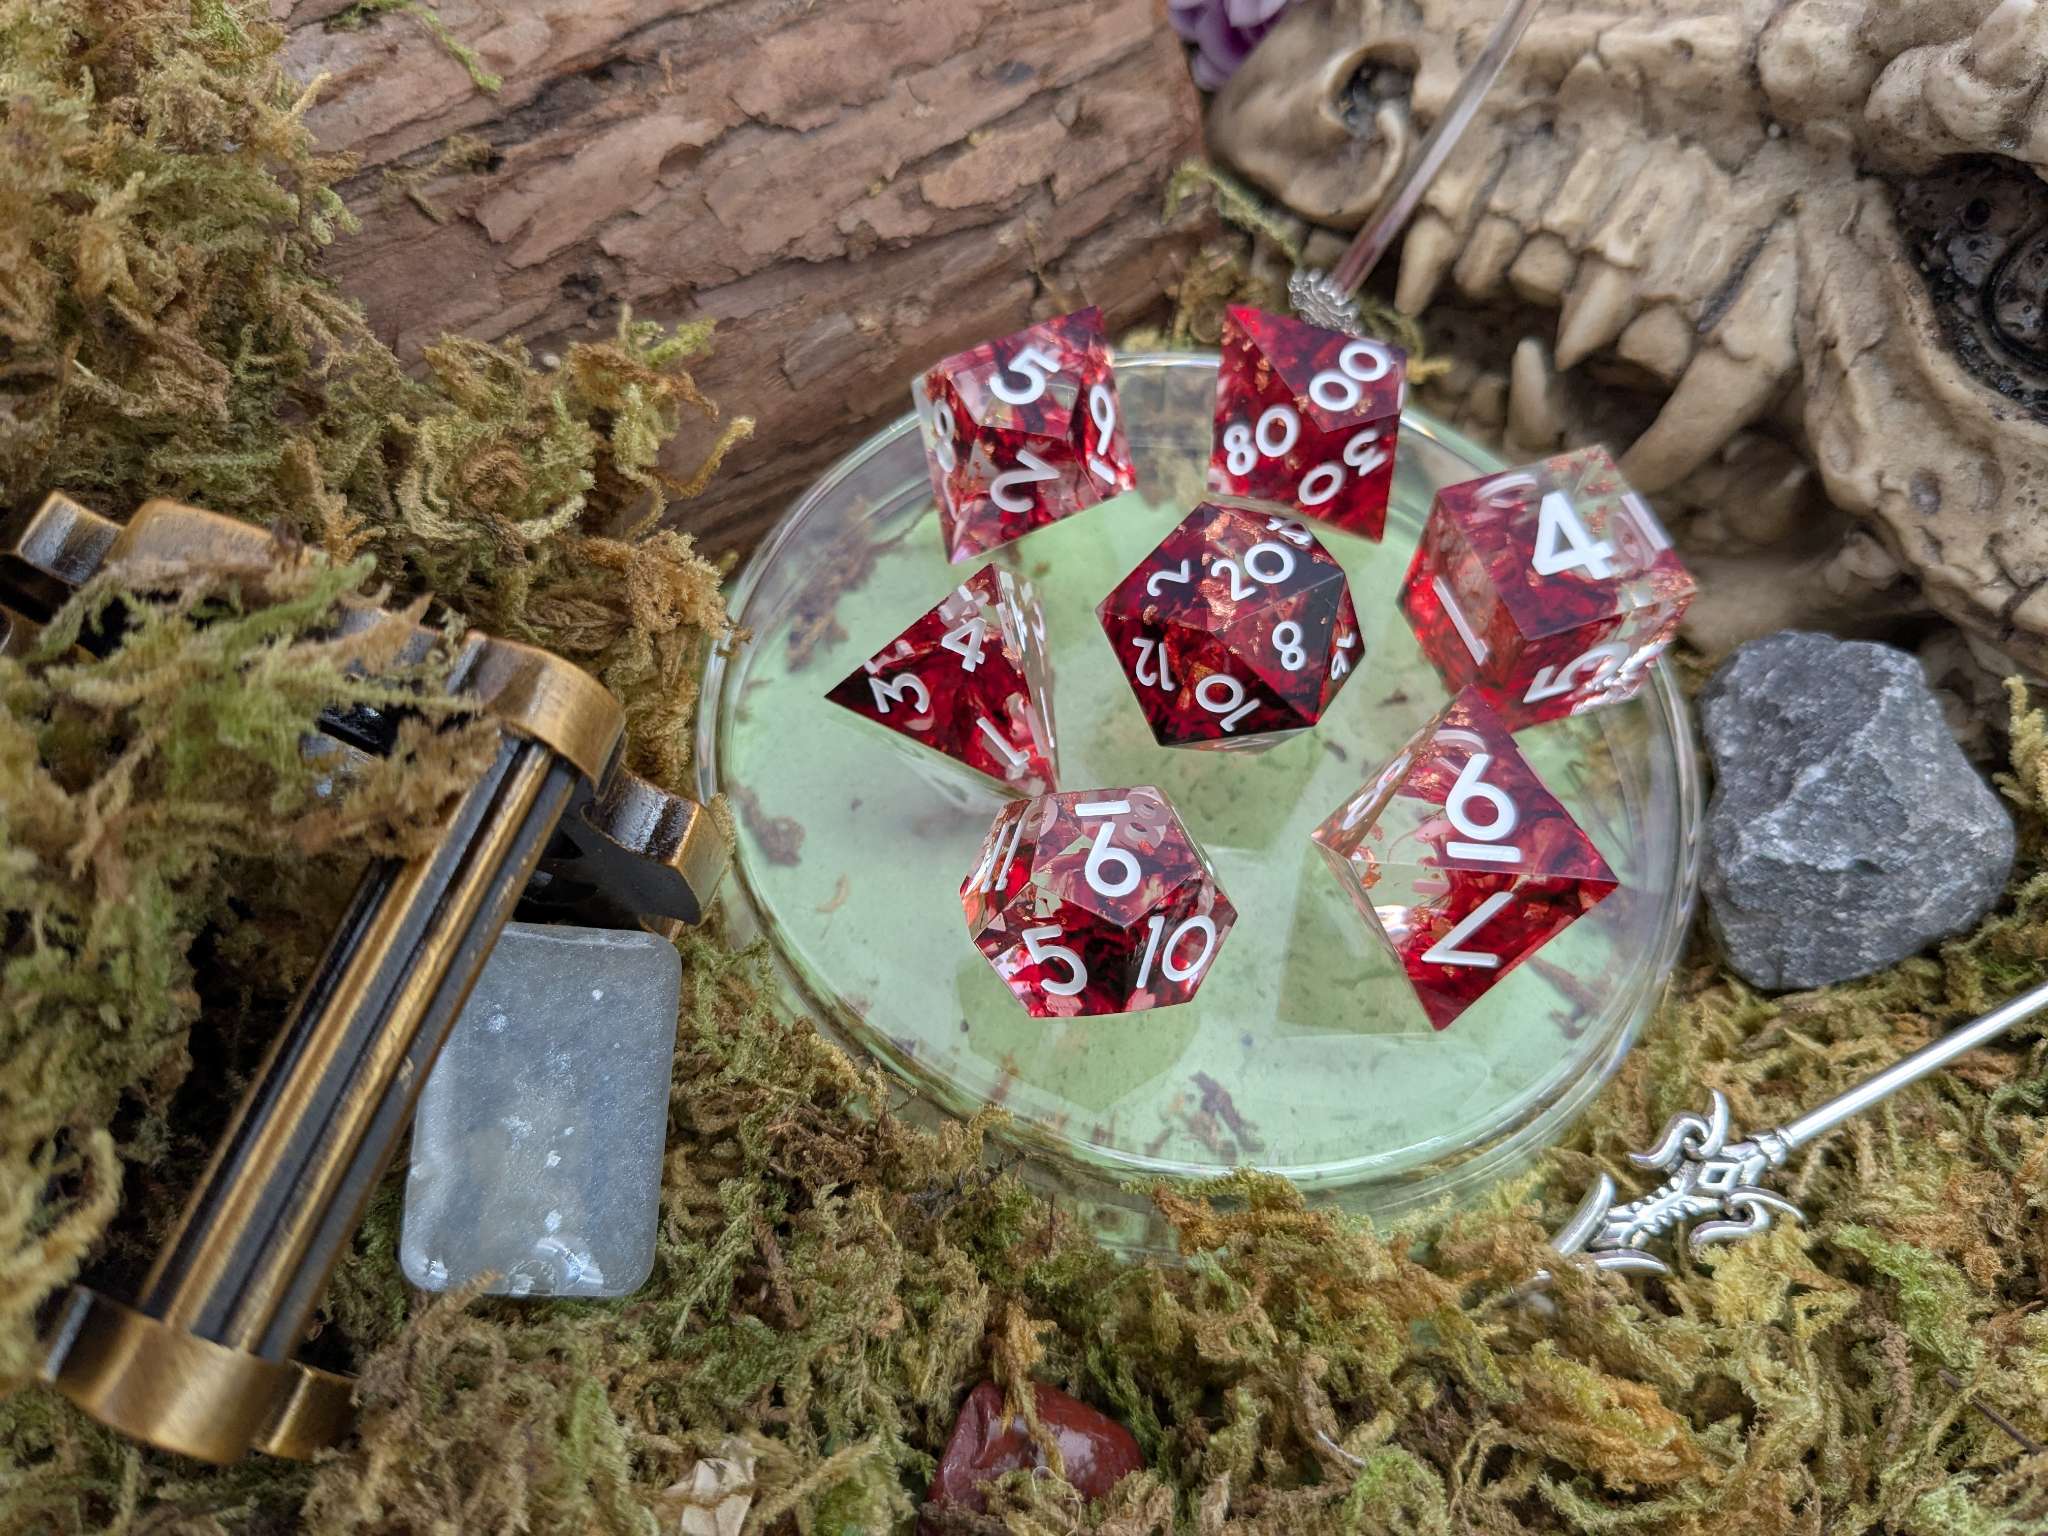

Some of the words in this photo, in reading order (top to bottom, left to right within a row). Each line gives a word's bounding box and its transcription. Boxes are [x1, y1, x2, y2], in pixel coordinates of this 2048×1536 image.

[989, 346, 1061, 405] 5
[1309, 340, 1392, 412] 00
[1223, 403, 1300, 477] 80
[1531, 490, 1616, 580] 4
[1146, 559, 1190, 597] 2
[1210, 542, 1295, 602] 20
[941, 617, 987, 673] 4
[1132, 637, 1176, 692] 12
[1272, 621, 1308, 671] 8
[868, 673, 931, 714] 3
[1195, 673, 1262, 732] 10
[1446, 753, 1522, 863] 6
[1021, 923, 1088, 996] 5
[1136, 914, 1217, 989] 10
